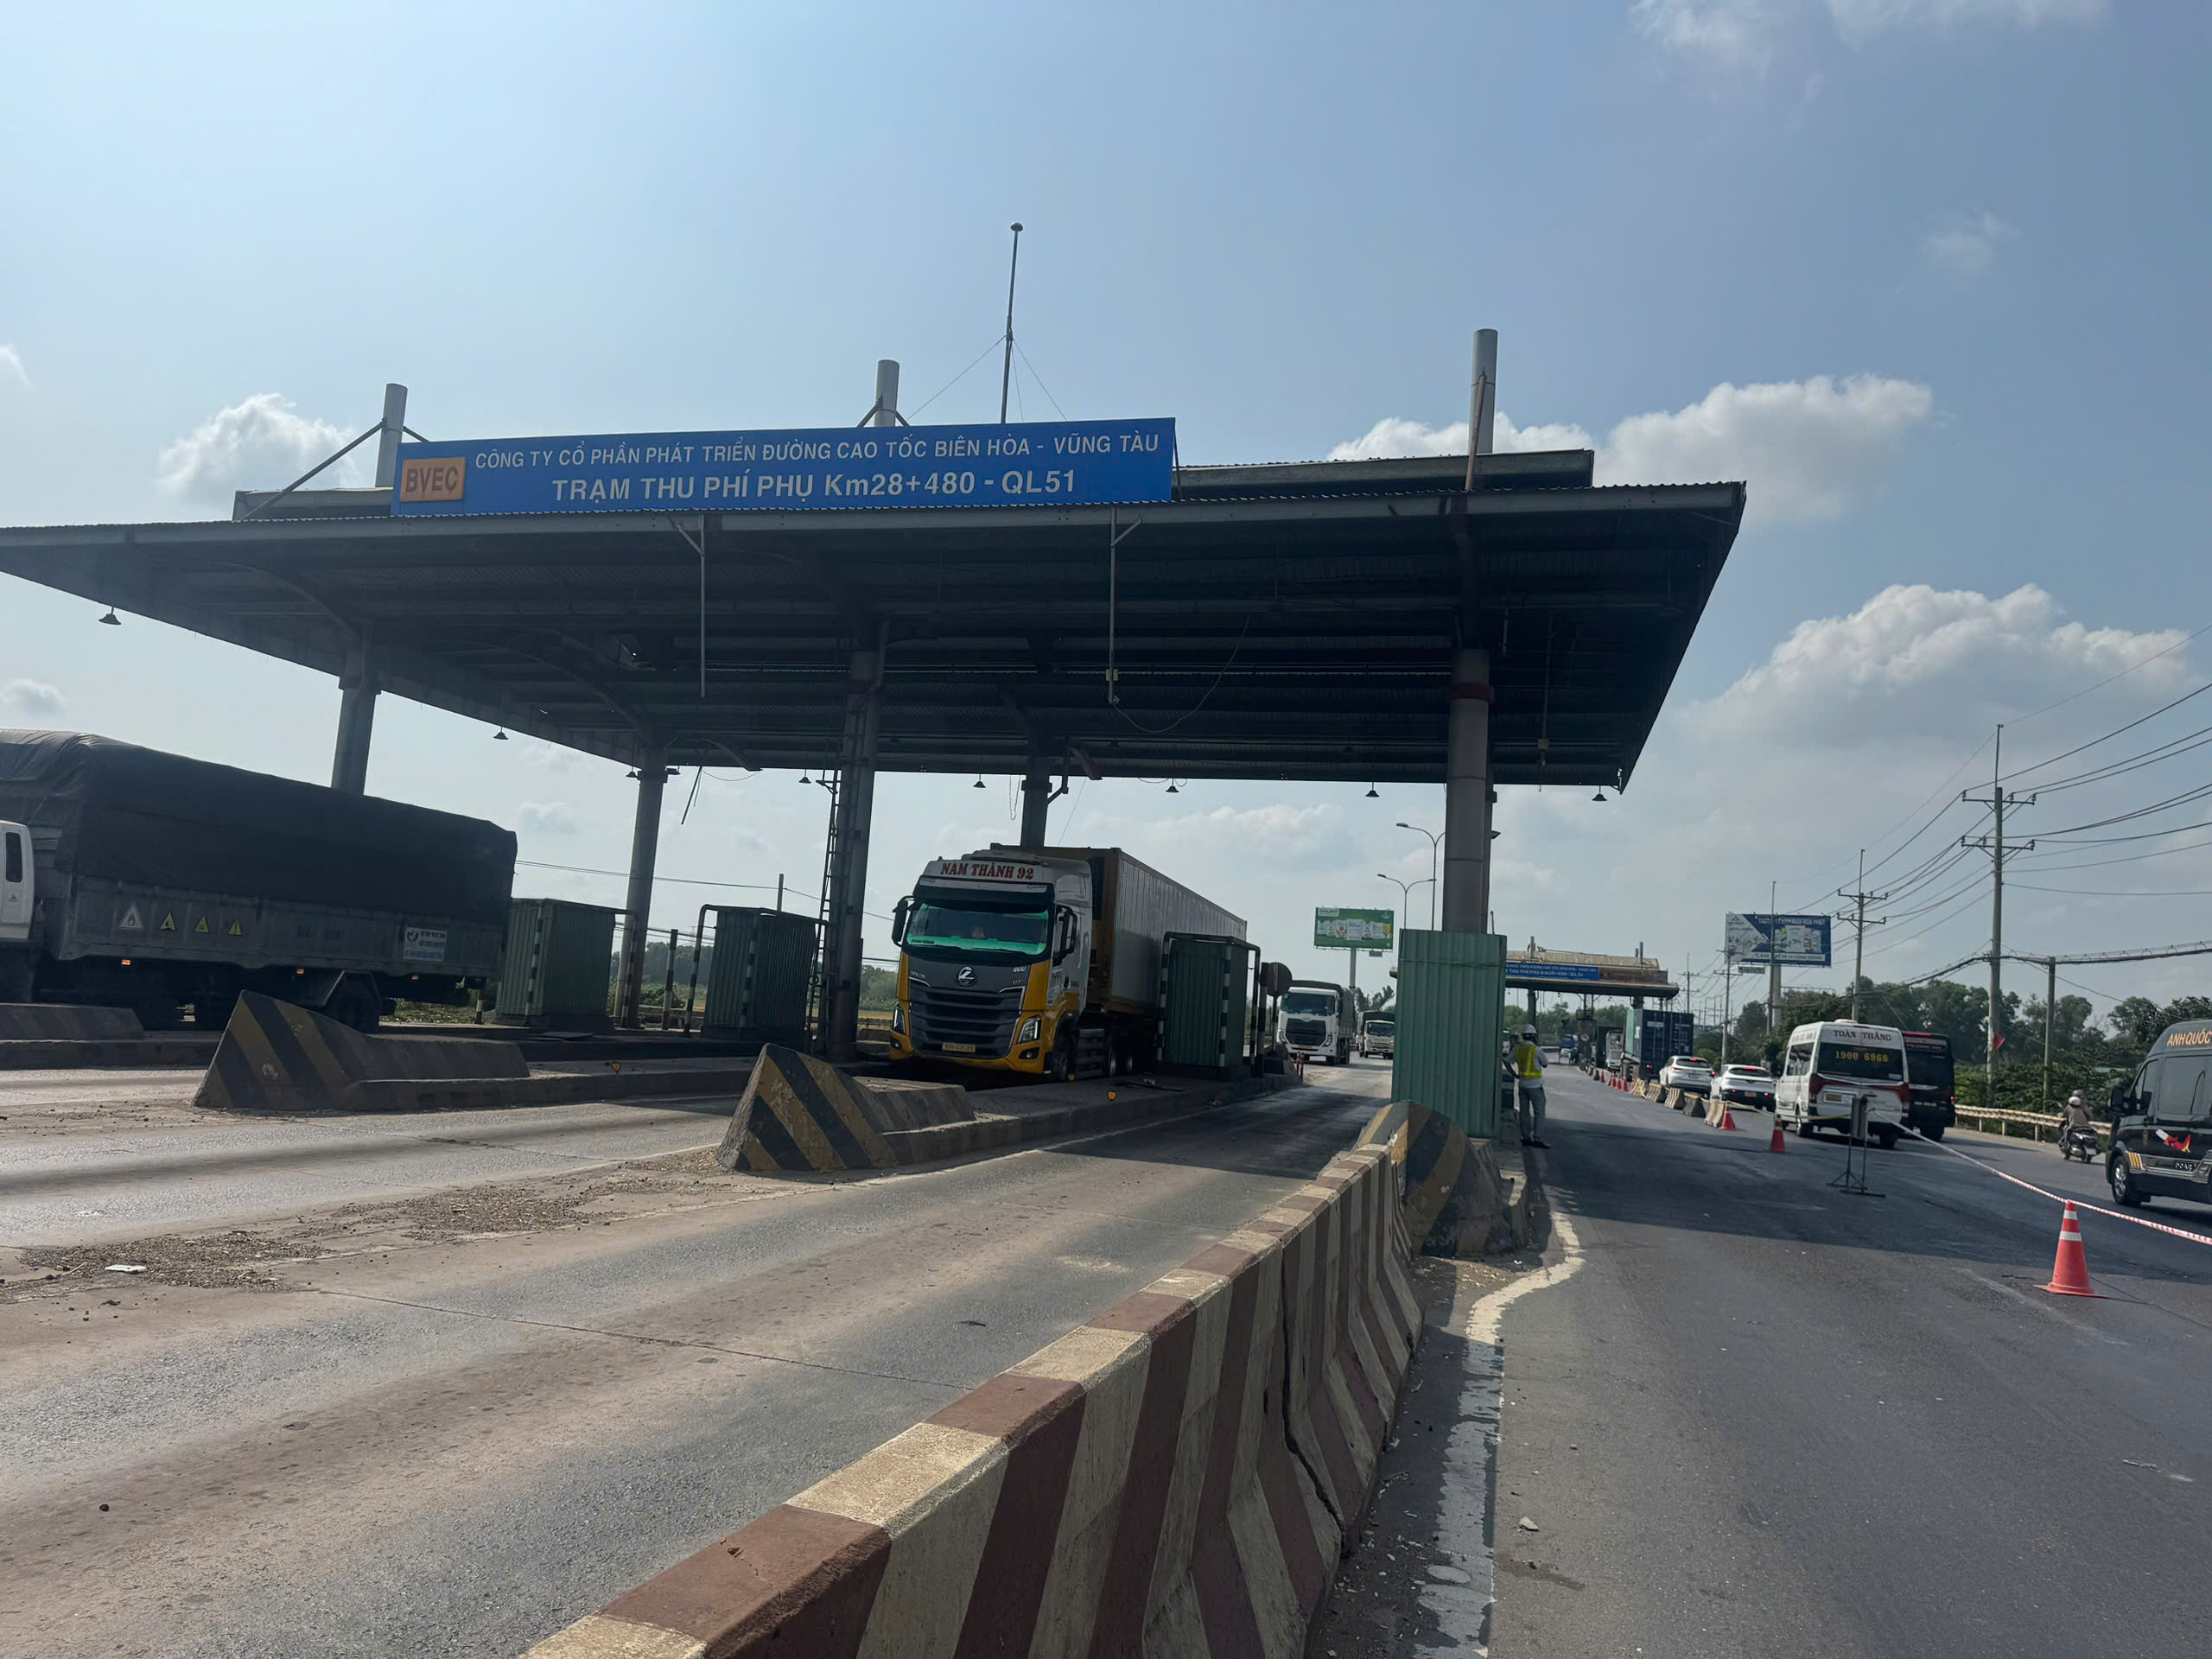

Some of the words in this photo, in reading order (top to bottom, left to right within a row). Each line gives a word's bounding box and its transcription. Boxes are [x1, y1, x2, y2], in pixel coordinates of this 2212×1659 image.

[476, 448, 524, 468] CÔNG
[530, 450, 553, 467] TY
[559, 440, 585, 466] CỔ
[590, 442, 639, 465] PHẦN
[645, 442, 695, 464] PHÁT
[702, 436, 756, 462] TRIỂN
[762, 439, 831, 461] ĐƯỜNG
[836, 442, 878, 459] CAO
[886, 433, 927, 459] TỐC
[934, 435, 980, 457] BIÊN
[988, 433, 1030, 455] HÒA
[1054, 432, 1111, 454] VŨNG
[1120, 430, 1159, 452] TÀU
[405, 467, 459, 493] BVEC
[552, 478, 630, 505] TRẠM
[640, 476, 695, 499] THU
[704, 468, 751, 499] PHÍ
[757, 474, 814, 502] PHỤ
[824, 472, 975, 496] Km28+480
[1001, 469, 1075, 495] QL51
[940, 862, 968, 875] NAM
[971, 862, 1014, 878] THÀNH
[1017, 867, 1034, 880] 92
